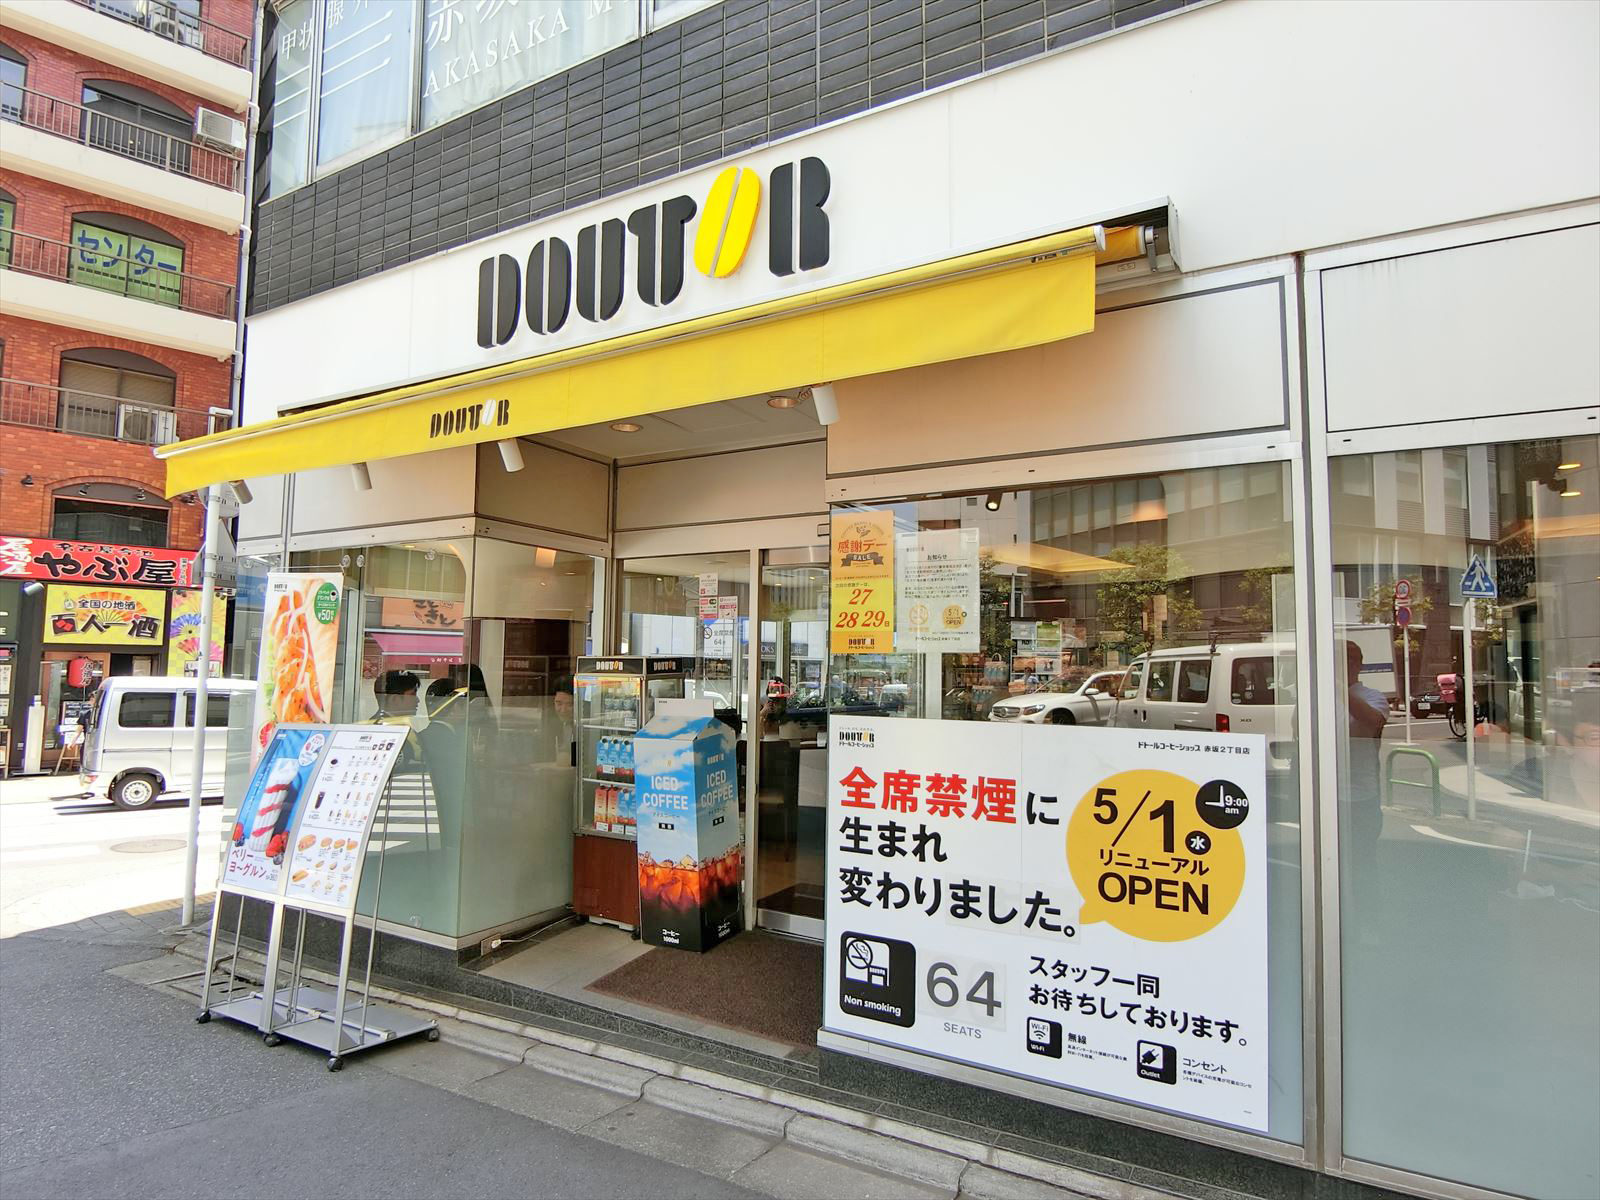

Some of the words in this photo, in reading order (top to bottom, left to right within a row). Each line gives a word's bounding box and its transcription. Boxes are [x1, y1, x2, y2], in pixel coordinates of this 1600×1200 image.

[422, 8, 571, 97] AKASAKA
[78, 229, 177, 275] センター
[477, 155, 831, 349] DOUTOR
[429, 399, 510, 438] DOUTOR
[838, 539, 887, 553] 感謝デー
[34, 551, 177, 585] やぶ屋
[849, 588, 873, 605] 27
[835, 611, 859, 628] 28
[839, 731, 875, 742] DOUTOR
[651, 776, 678, 791] ICED
[707, 769, 726, 788] ICED
[643, 793, 689, 811] COFFEE
[701, 784, 733, 808] COFFEE
[839, 766, 1060, 825] 全席禁煙に
[1224, 795, 1248, 807] 9:00
[1093, 788, 1175, 853] 5/1
[1225, 806, 1239, 815] am
[839, 816, 948, 862] 生まれ
[1190, 836, 1206, 850] 水
[1100, 848, 1210, 876] リニューアル
[839, 866, 1076, 938] 変わりました。
[1098, 872, 1209, 915] OPEN
[926, 962, 1002, 1017] 64
[844, 994, 863, 1007] Non
[864, 1000, 901, 1017] smoking
[1029, 984, 1247, 1046] お待ちしております。
[943, 1022, 982, 1039] SEATS
[1031, 1023, 1049, 1032] Wi-Fi
[1068, 1032, 1087, 1045] 無線
[1140, 1069, 1160, 1079] Outlet
[1183, 1058, 1227, 1075] コンセント
